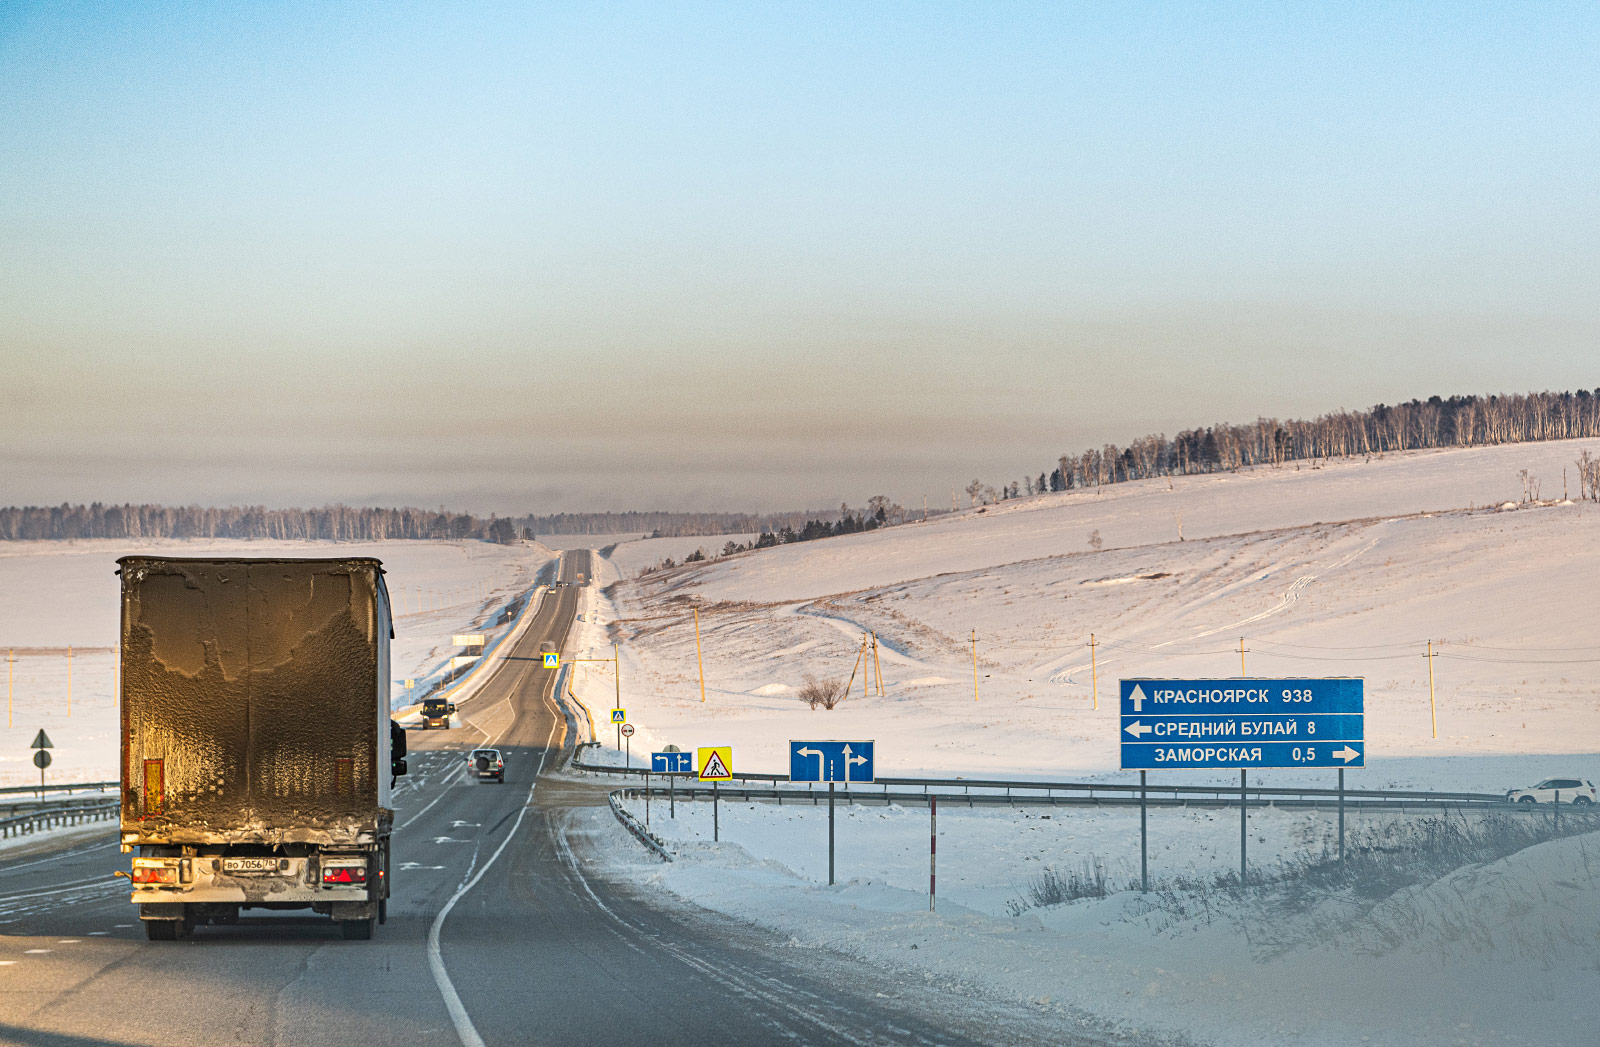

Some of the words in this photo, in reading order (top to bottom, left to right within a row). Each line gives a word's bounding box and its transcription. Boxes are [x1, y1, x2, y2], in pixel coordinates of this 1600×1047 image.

[1153, 689, 1269, 703] КРАСНОЯРСК
[1281, 689, 1313, 703] 938
[1154, 719, 1236, 738] СРЕДНИЙ
[1240, 718, 1297, 735] БУЛАЙ
[1307, 721, 1316, 734] 8
[1154, 747, 1262, 762] ЗАМОРСКАЯ
[1292, 747, 1316, 763] 0,5
[240, 860, 262, 869] 7056
